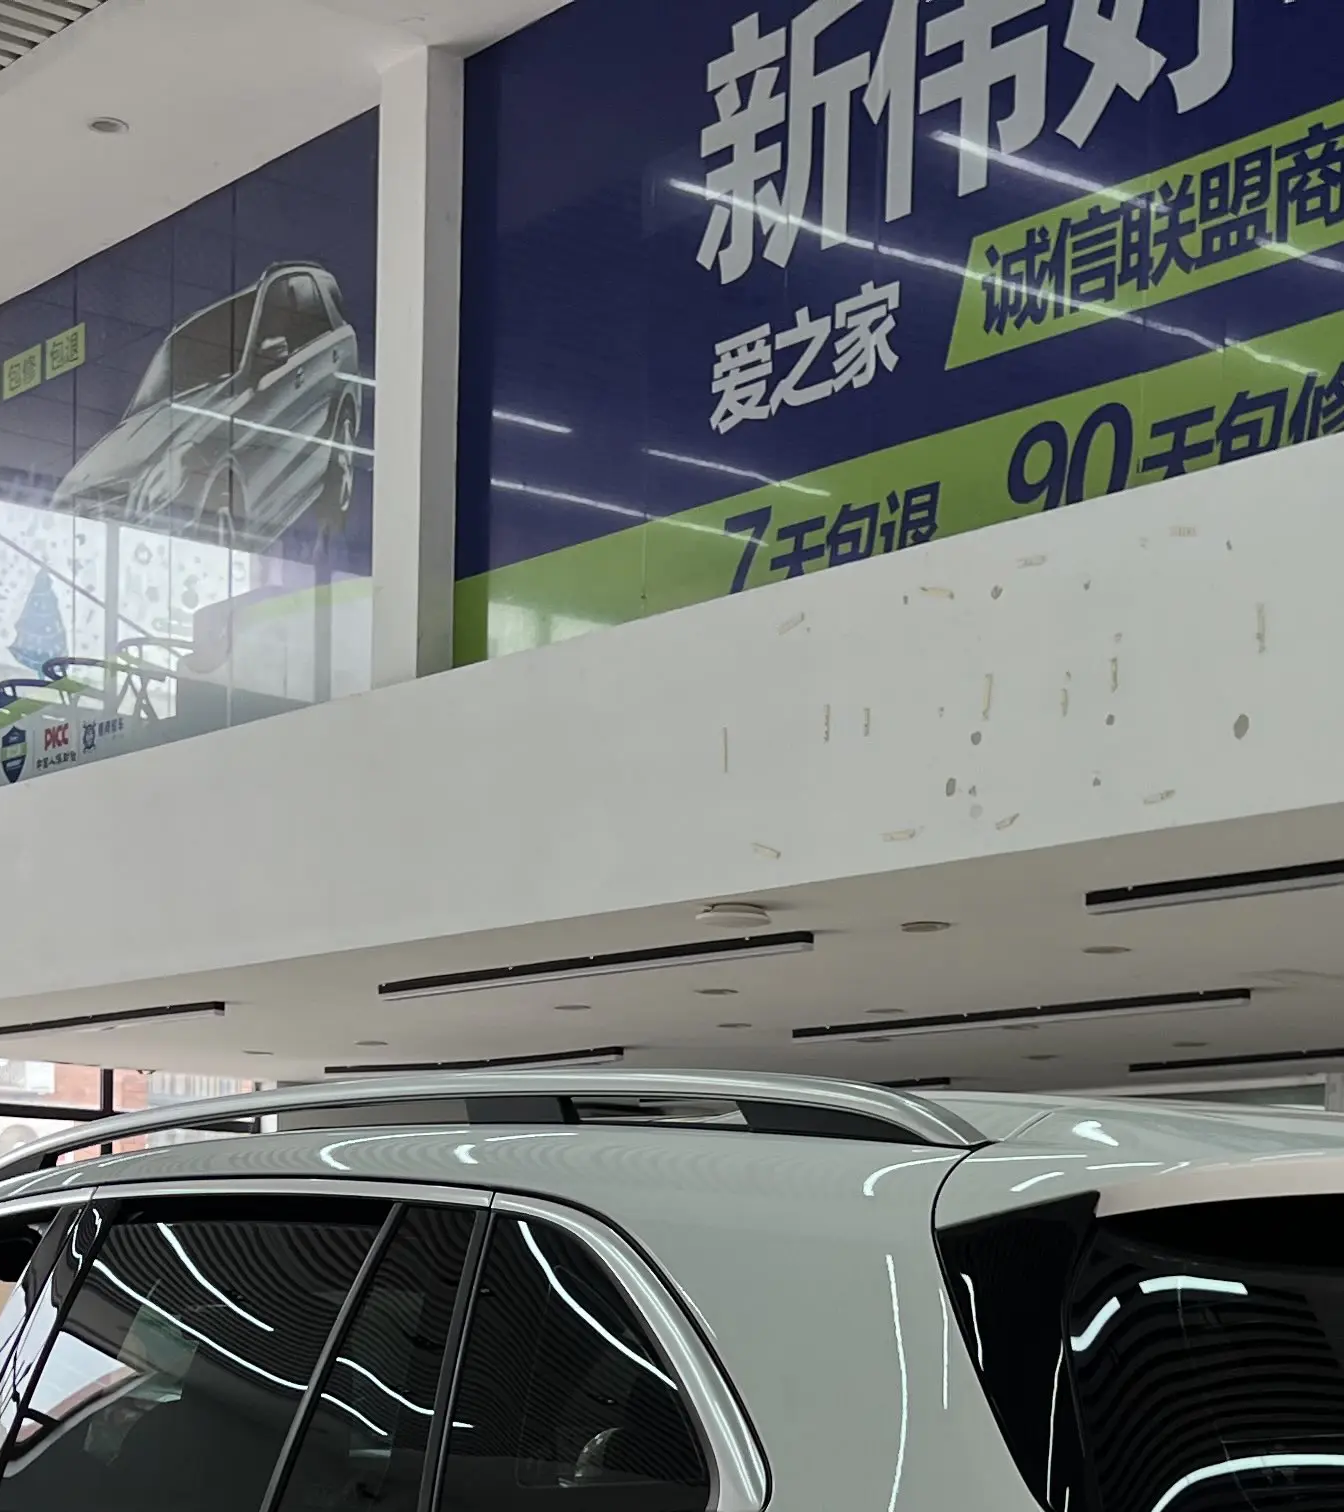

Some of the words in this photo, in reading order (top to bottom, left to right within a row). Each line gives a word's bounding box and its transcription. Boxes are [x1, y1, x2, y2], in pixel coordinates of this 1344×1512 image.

[710, 281, 902, 433] 爱之家
[44, 722, 69, 751] PICC
